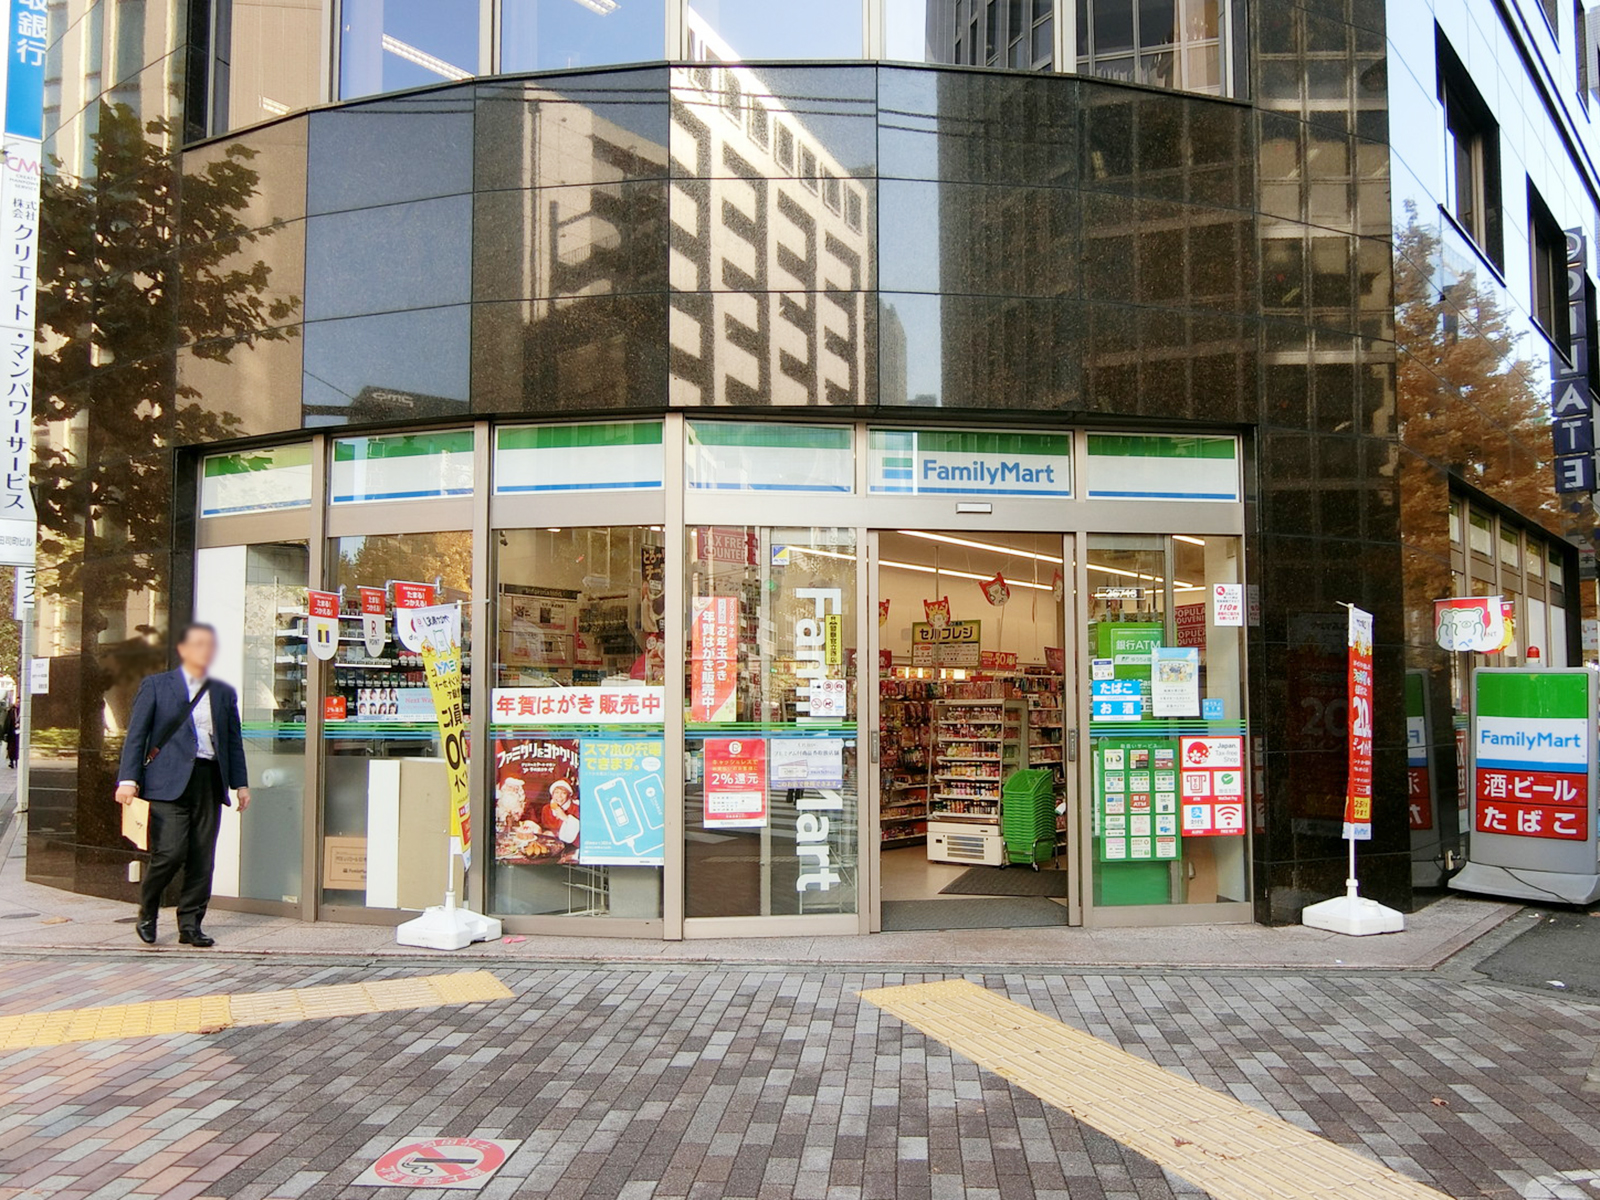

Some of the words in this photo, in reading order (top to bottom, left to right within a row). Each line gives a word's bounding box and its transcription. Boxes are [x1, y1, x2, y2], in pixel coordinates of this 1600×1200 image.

[922, 458, 1054, 485] FamilyMart
[716, 626, 727, 681] お年玉つき
[1116, 640, 1160, 651] 銀行ATM
[1100, 683, 1133, 695] たばこ
[496, 694, 594, 716] 年賀はがき
[599, 694, 661, 715] 販売中
[1100, 702, 1134, 715] お酒
[1481, 730, 1581, 751] FamilyMart
[584, 757, 640, 771] できます。
[712, 773, 759, 785] 2%還元
[1484, 806, 1577, 835] たばこ
